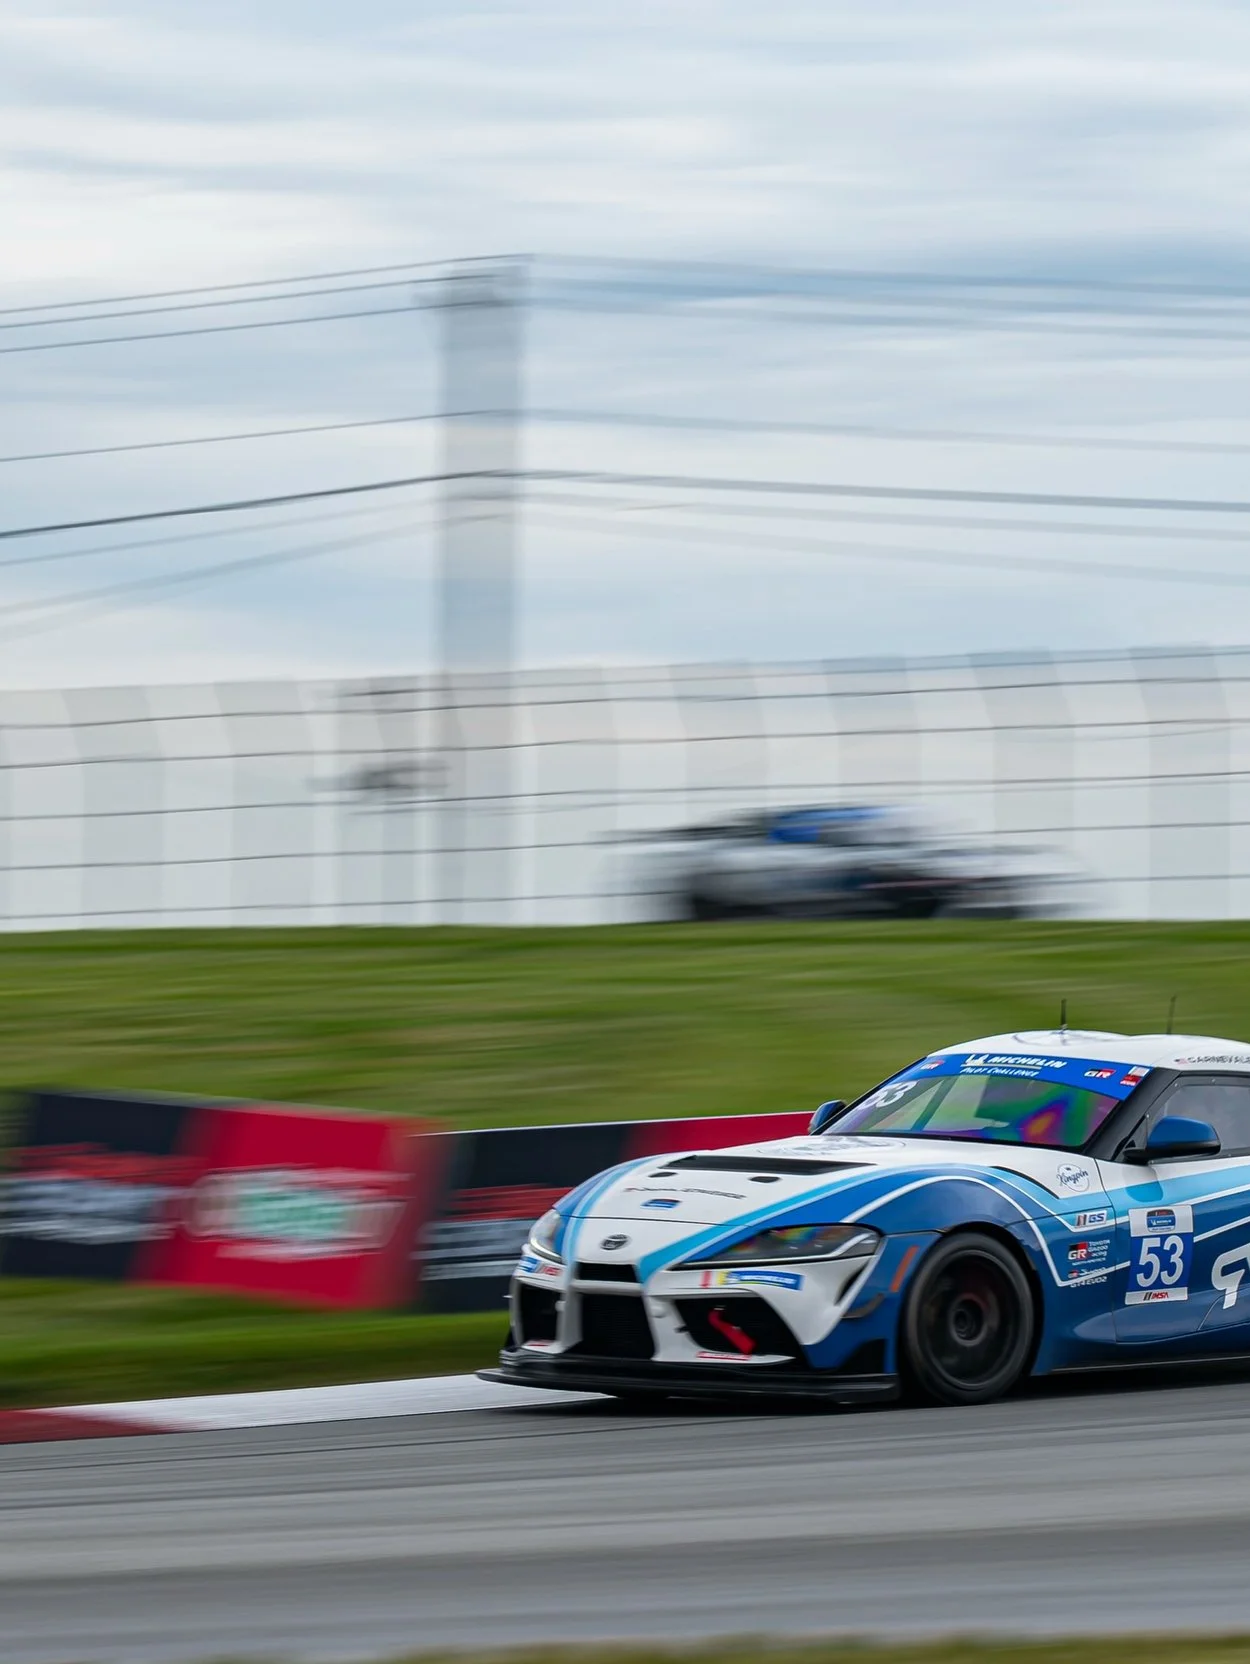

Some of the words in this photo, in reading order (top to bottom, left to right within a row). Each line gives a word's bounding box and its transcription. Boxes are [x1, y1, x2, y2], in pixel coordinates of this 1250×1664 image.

[987, 1055, 1068, 1069] MICHELIN
[959, 1066, 988, 1075] PILOT
[987, 1067, 1040, 1078] CHALLENGE
[1083, 1068, 1113, 1079] GR
[1088, 1212, 1106, 1224] GS
[1068, 1248, 1088, 1260] GR
[1136, 1235, 1184, 1288] 53
